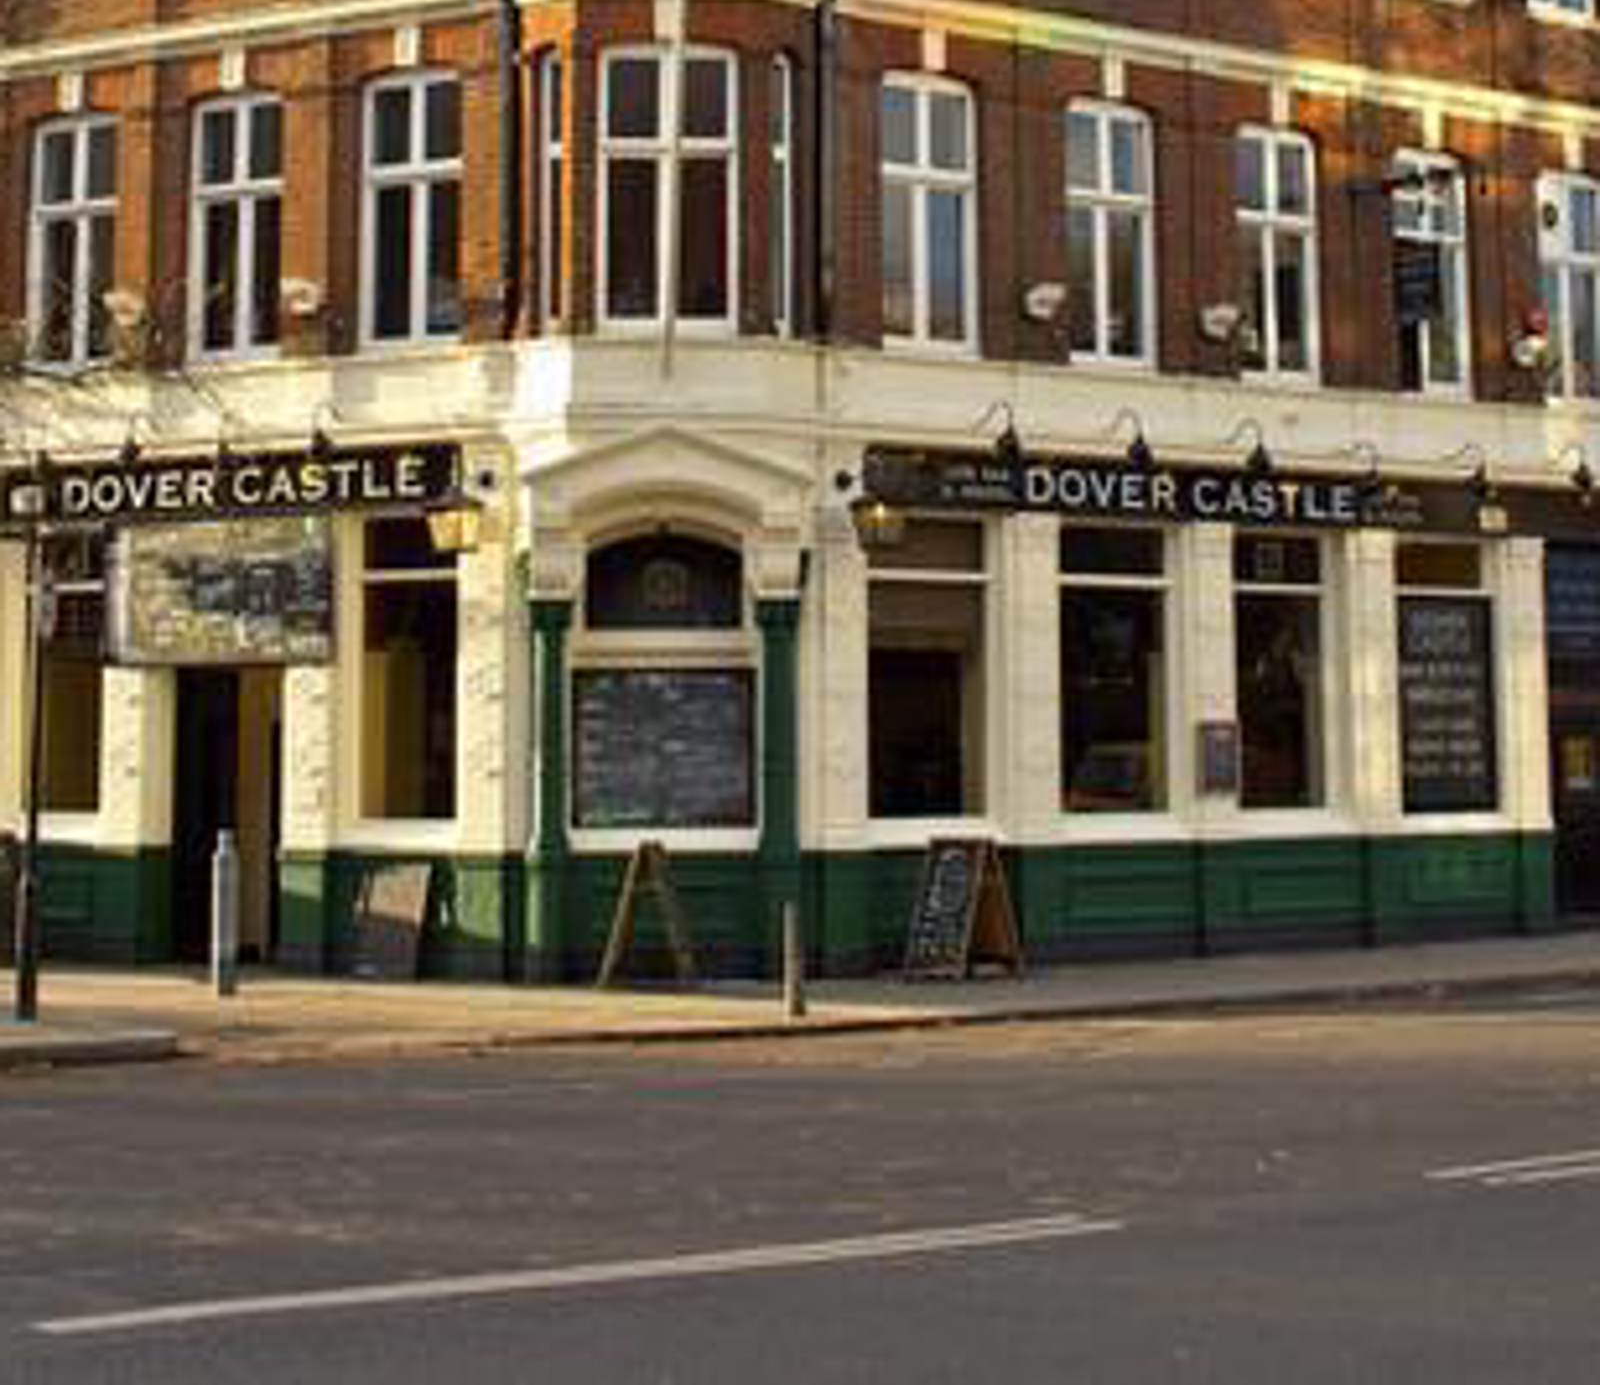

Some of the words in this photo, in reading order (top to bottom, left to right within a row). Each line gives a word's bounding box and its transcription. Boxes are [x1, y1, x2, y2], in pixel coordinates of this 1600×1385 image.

[62, 470, 216, 513] DOVER
[232, 457, 426, 502] CASTLE
[1025, 468, 1177, 513] DOVER
[1192, 483, 1357, 521] CASTLE
